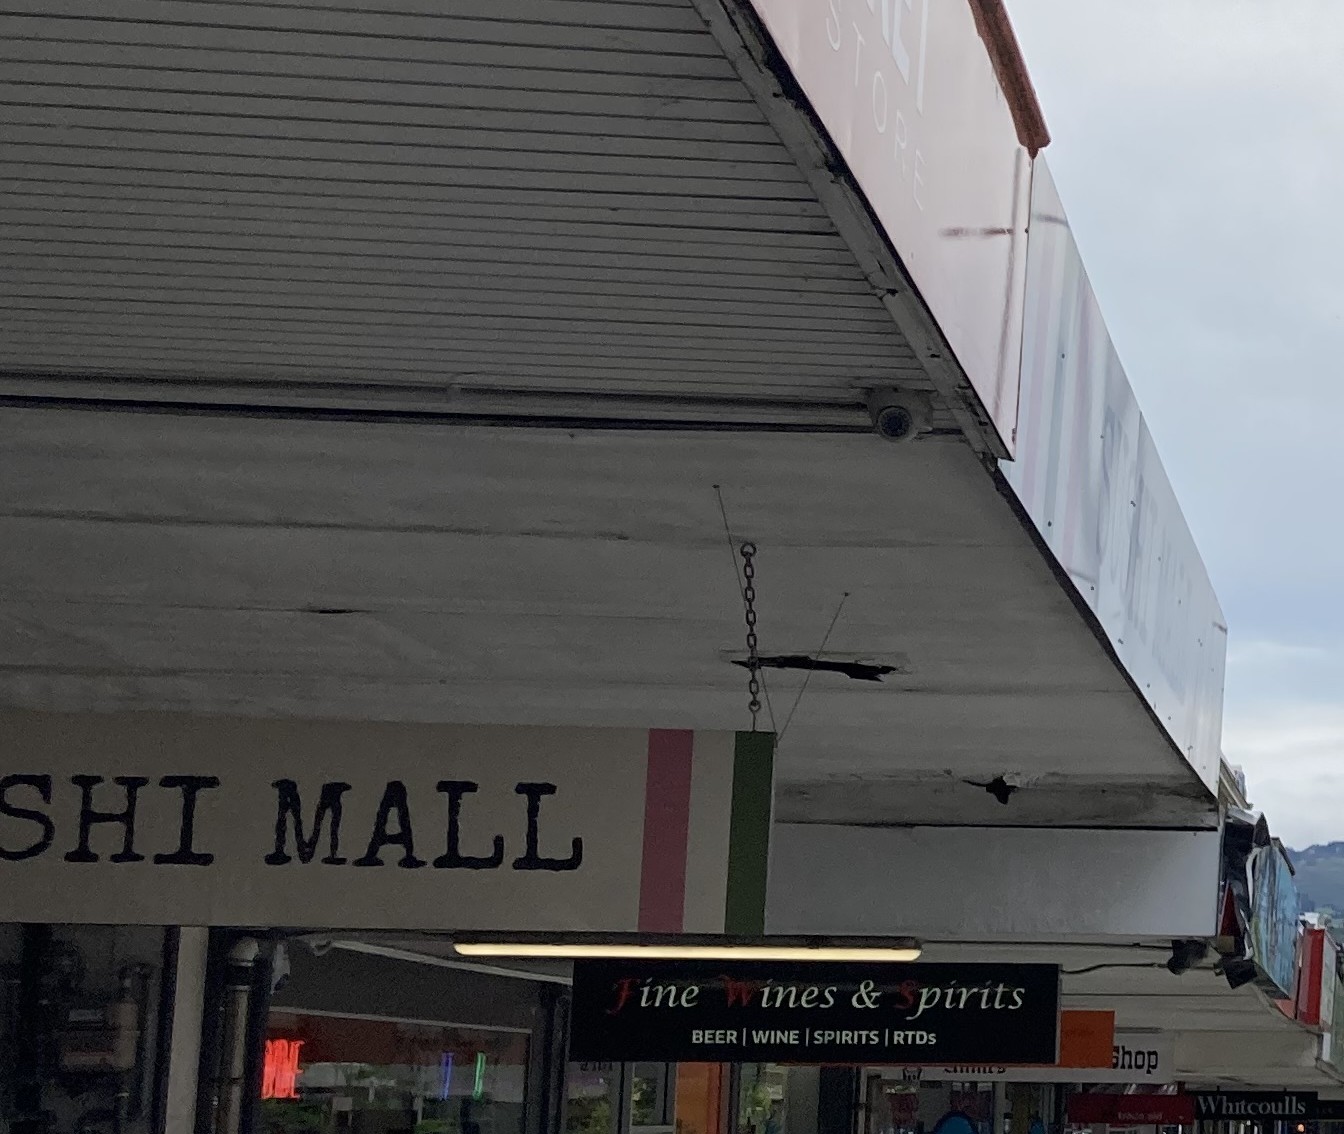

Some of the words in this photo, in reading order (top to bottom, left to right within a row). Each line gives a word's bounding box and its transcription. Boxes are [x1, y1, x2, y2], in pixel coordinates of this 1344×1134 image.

[264, 779, 585, 872] MALL
[607, 976, 700, 1016] Fine
[720, 975, 838, 1009] Wines
[850, 979, 881, 1010] &
[896, 977, 1025, 1021] Spirits
[692, 1029, 738, 1046] BEER
[752, 1029, 800, 1046] WINE
[813, 1028, 880, 1046] SPIRITS
[893, 1029, 937, 1046] RTDs
[1198, 1096, 1306, 1115] Whitcoulls
